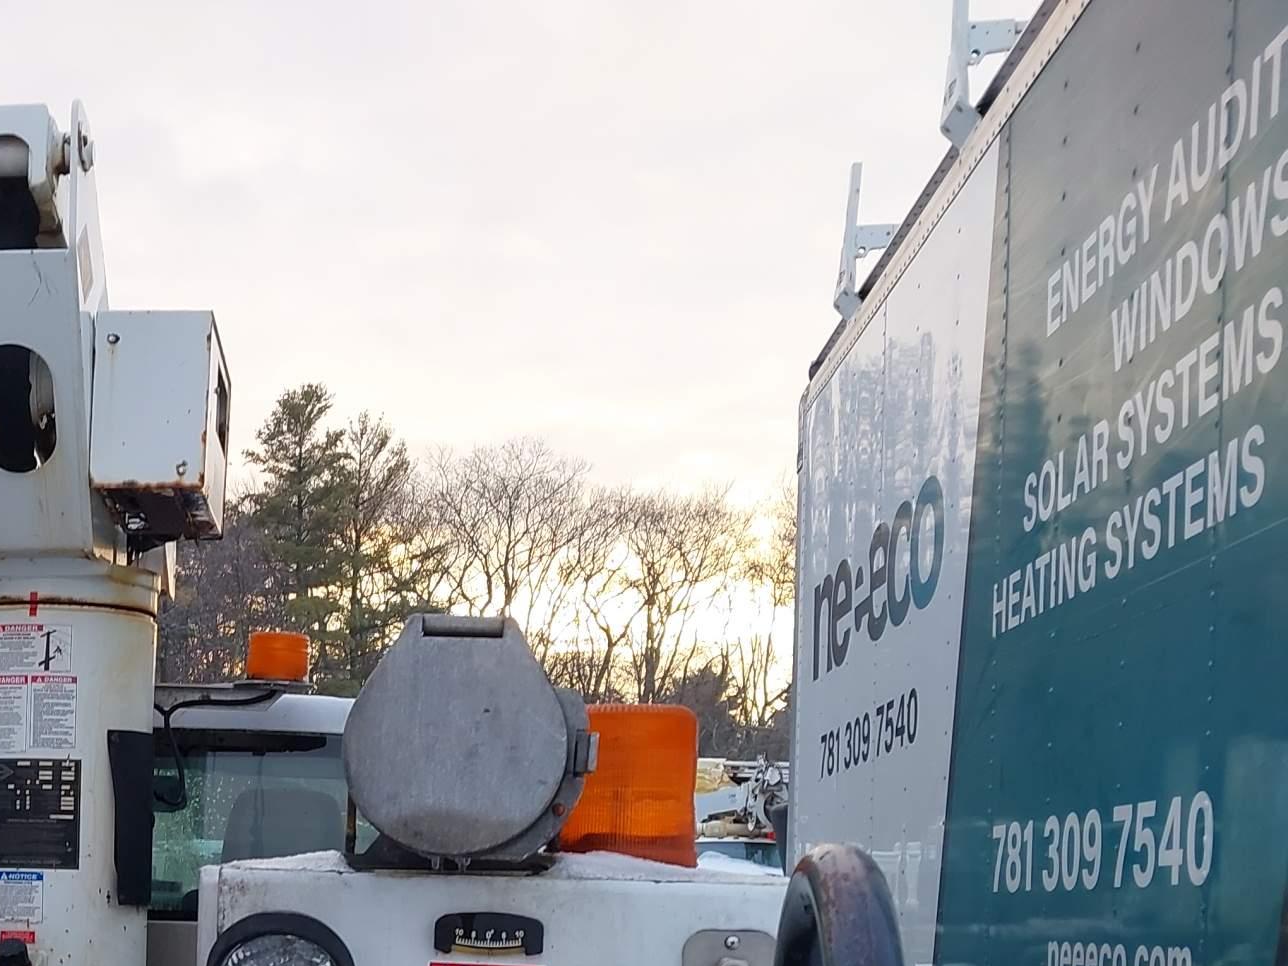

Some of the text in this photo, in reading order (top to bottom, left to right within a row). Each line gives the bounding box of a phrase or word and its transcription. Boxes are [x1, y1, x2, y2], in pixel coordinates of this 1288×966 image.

[1046, 163, 1159, 338] ENERGY
[1111, 148, 1288, 373] WINDOWS
[1023, 286, 1284, 533] SOLAR SYSTEMS
[991, 424, 1266, 640] HEATING SYSTEMS
[4, 624, 38, 632] DANGER
[819, 686, 919, 780] 781 309 7540
[8, 872, 38, 880] NOTICE
[992, 790, 1213, 894] 781 309 7540
